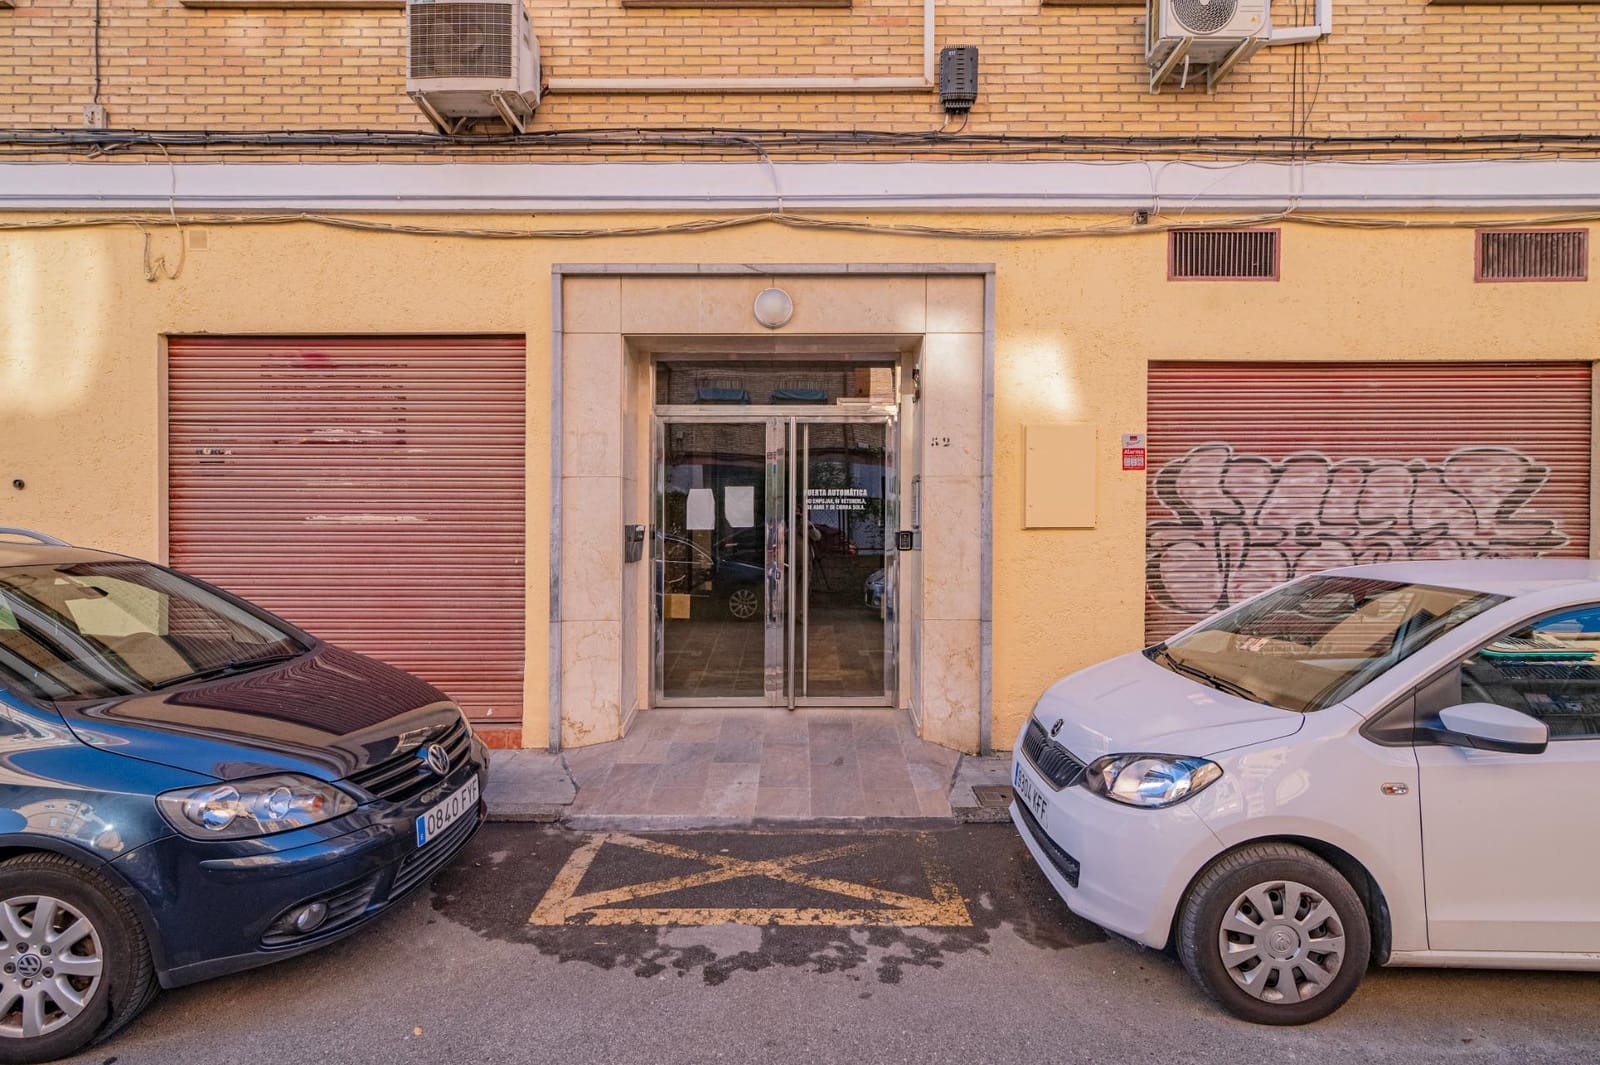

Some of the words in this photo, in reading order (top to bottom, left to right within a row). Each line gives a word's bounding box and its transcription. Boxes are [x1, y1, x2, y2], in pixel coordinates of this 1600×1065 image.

[828, 488, 868, 496] AUTOMÁTICA
[427, 797, 459, 836] 0840
[461, 779, 477, 811] FYF
